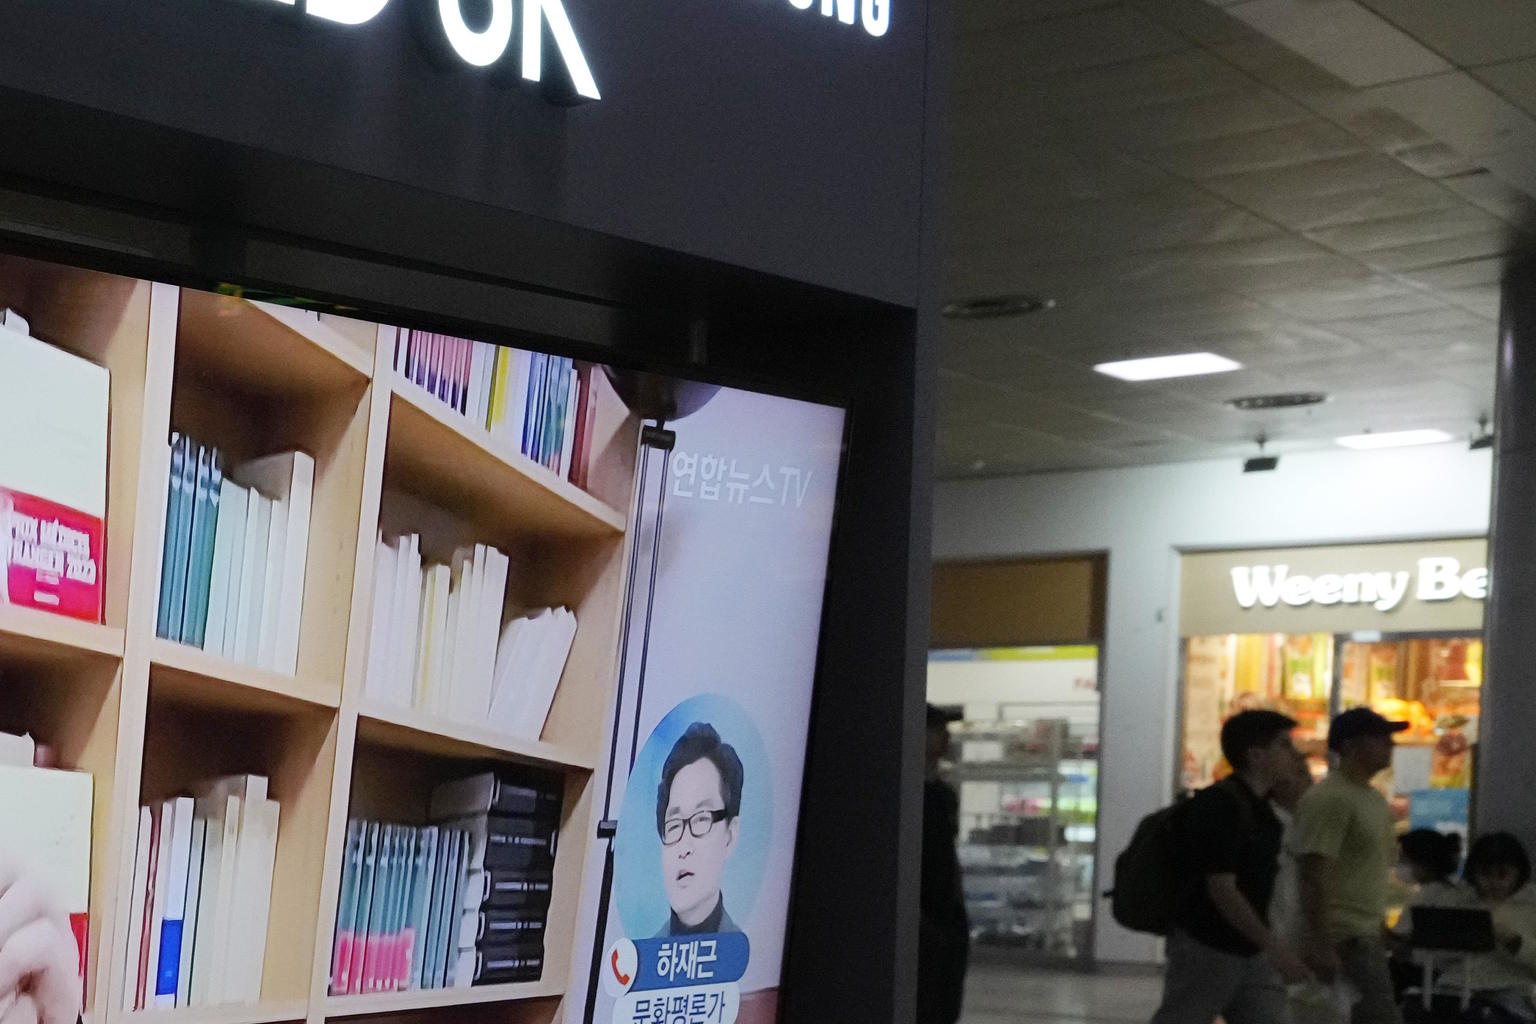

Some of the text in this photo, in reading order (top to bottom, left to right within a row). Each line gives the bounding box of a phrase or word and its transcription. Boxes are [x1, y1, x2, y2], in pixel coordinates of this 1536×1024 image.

[672, 450, 813, 509] 연합뉴스TV
[1230, 564, 1410, 612] Weeny
[656, 938, 718, 982] 하재근
